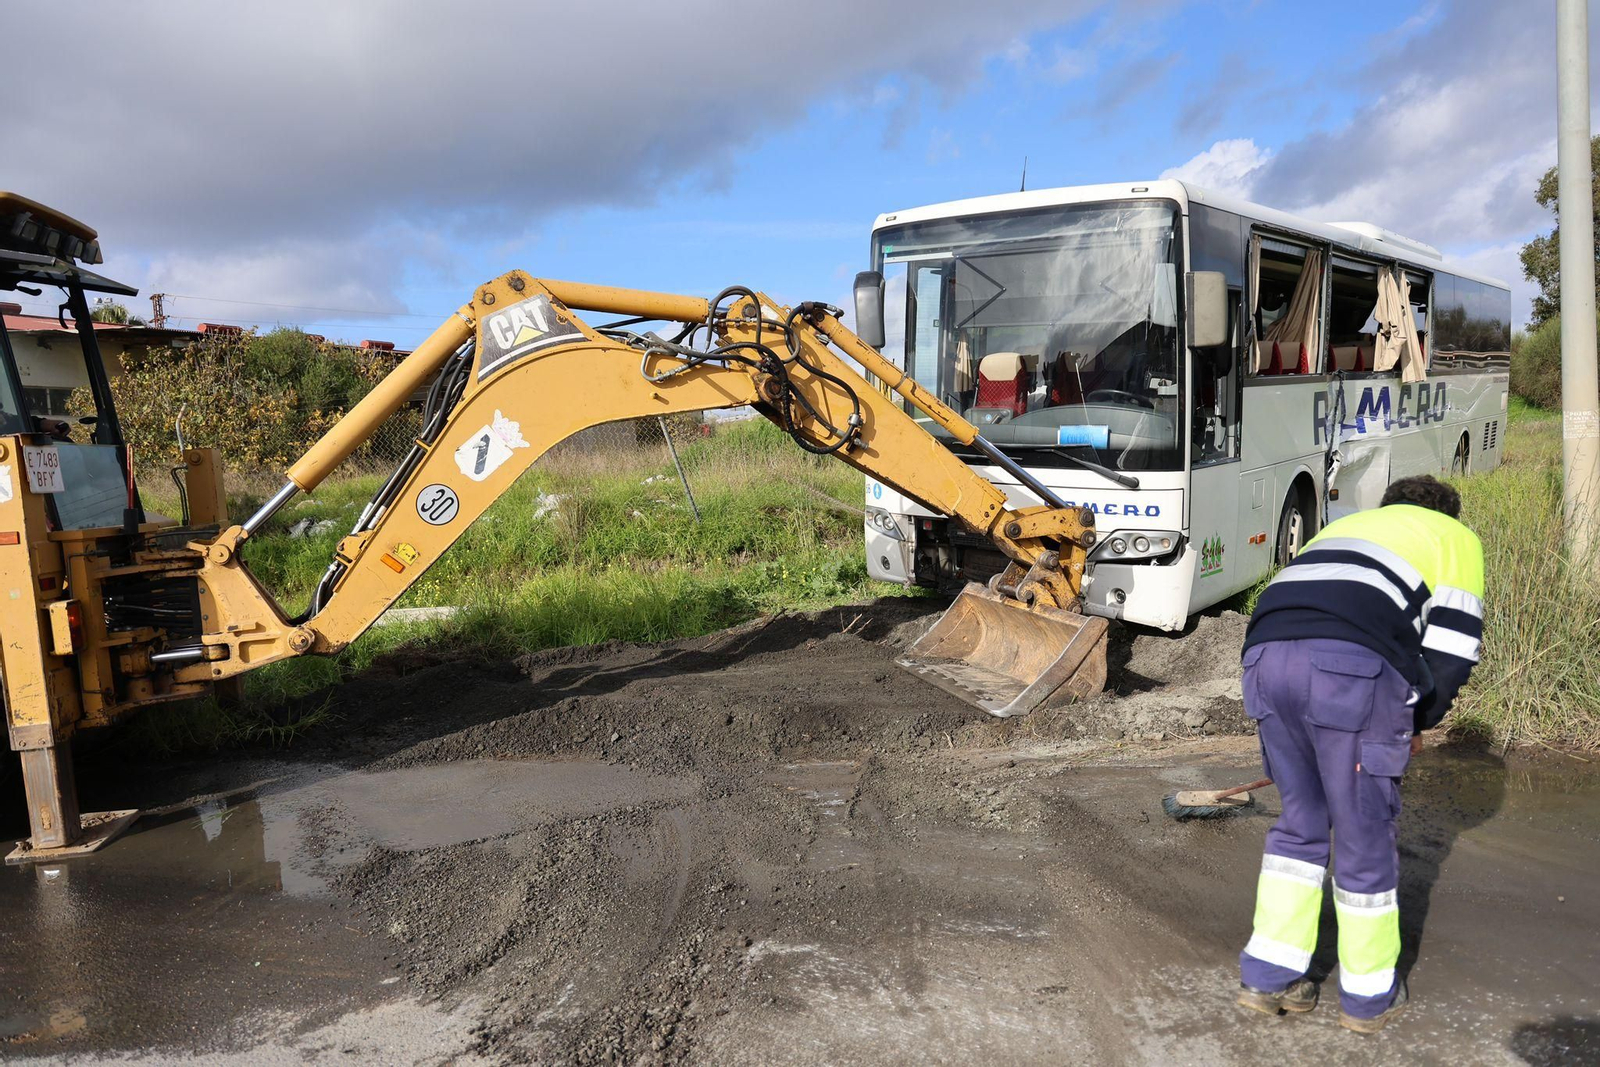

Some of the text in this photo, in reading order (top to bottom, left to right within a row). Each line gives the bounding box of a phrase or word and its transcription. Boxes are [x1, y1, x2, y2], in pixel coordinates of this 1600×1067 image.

[489, 299, 550, 350] CAT
[27, 452, 59, 468] E 7483
[37, 471, 55, 487] BFY
[420, 488, 455, 521] 30
[1044, 500, 1161, 517] MERO
